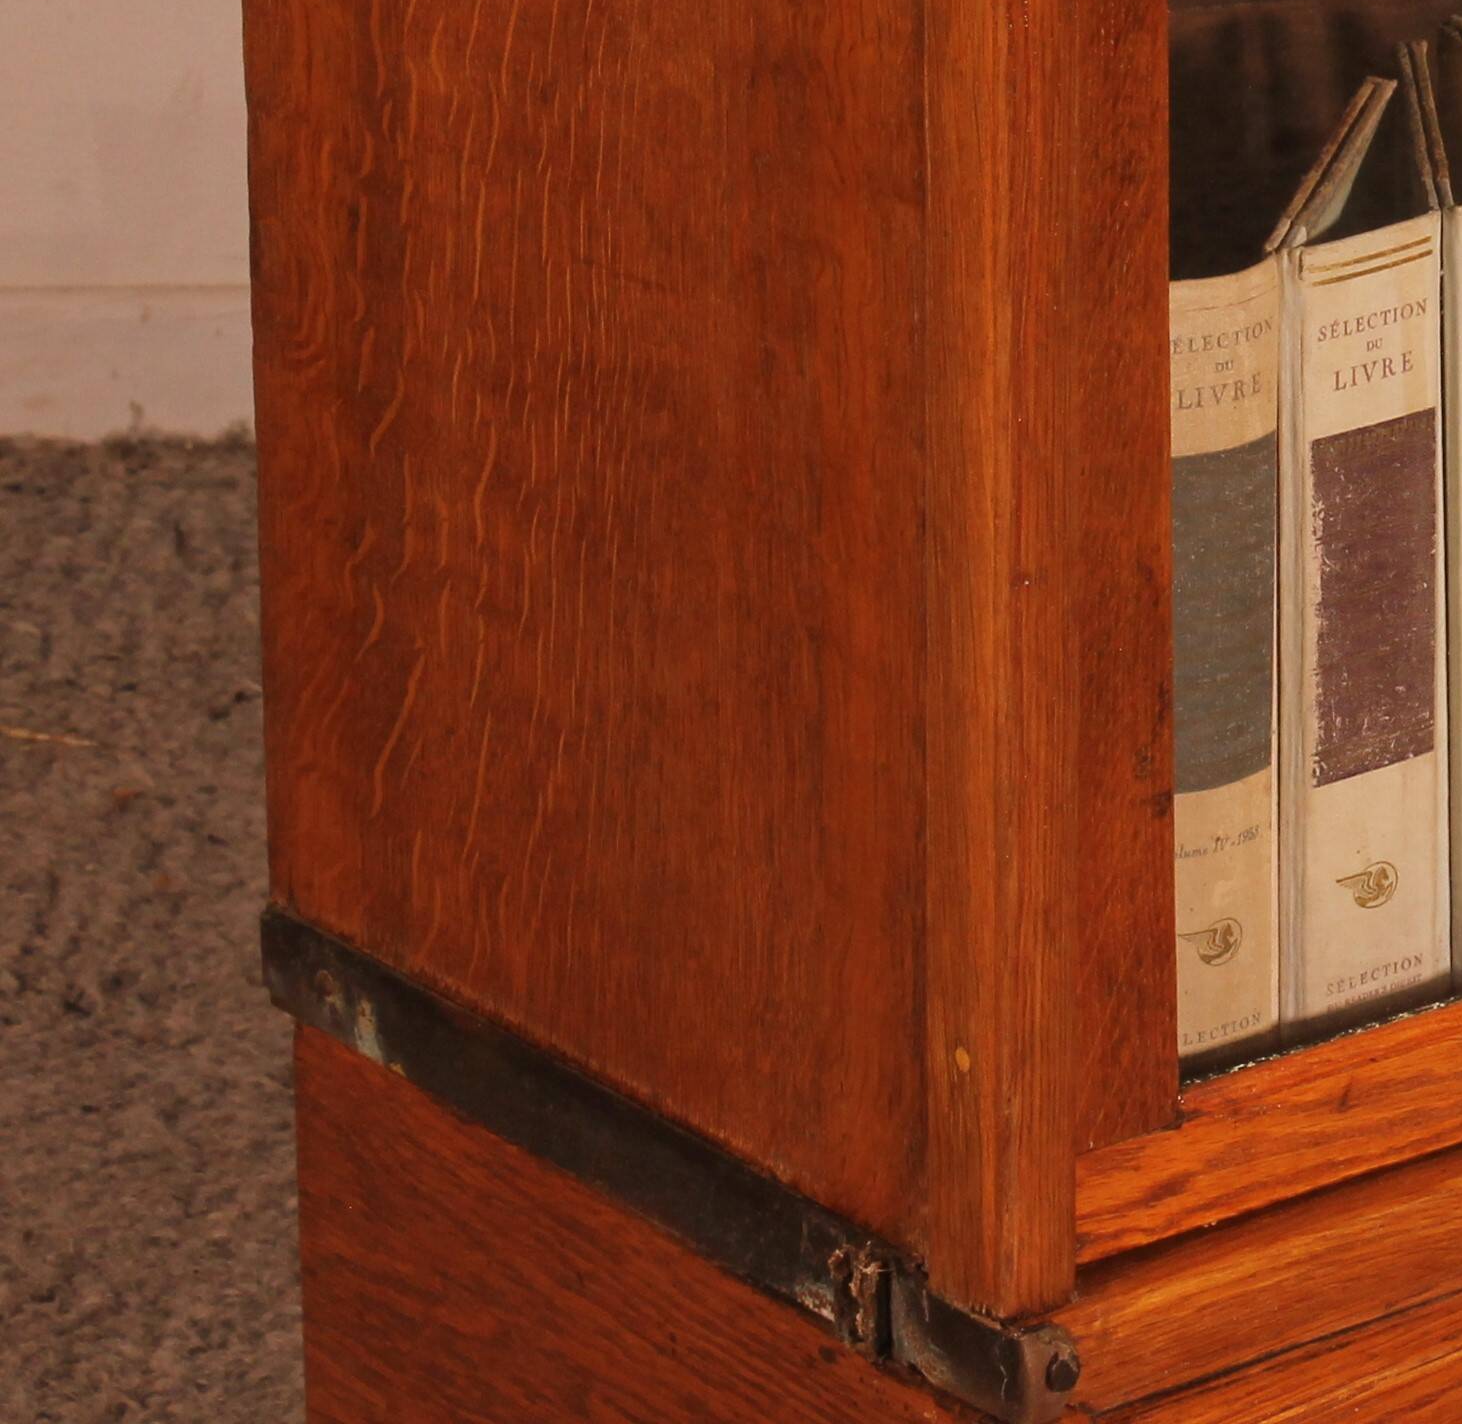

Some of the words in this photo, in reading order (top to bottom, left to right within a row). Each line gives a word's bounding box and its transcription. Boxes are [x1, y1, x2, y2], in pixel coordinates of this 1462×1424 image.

[1171, 316, 1274, 355] ÉLECTION
[1317, 298, 1429, 343] SÉLECTION
[1366, 337, 1383, 352] DU
[1215, 360, 1235, 374] DU
[1333, 350, 1415, 392] LIVRE
[1177, 371, 1264, 411] LIVRE
[1181, 1011, 1261, 1046] LECTION
